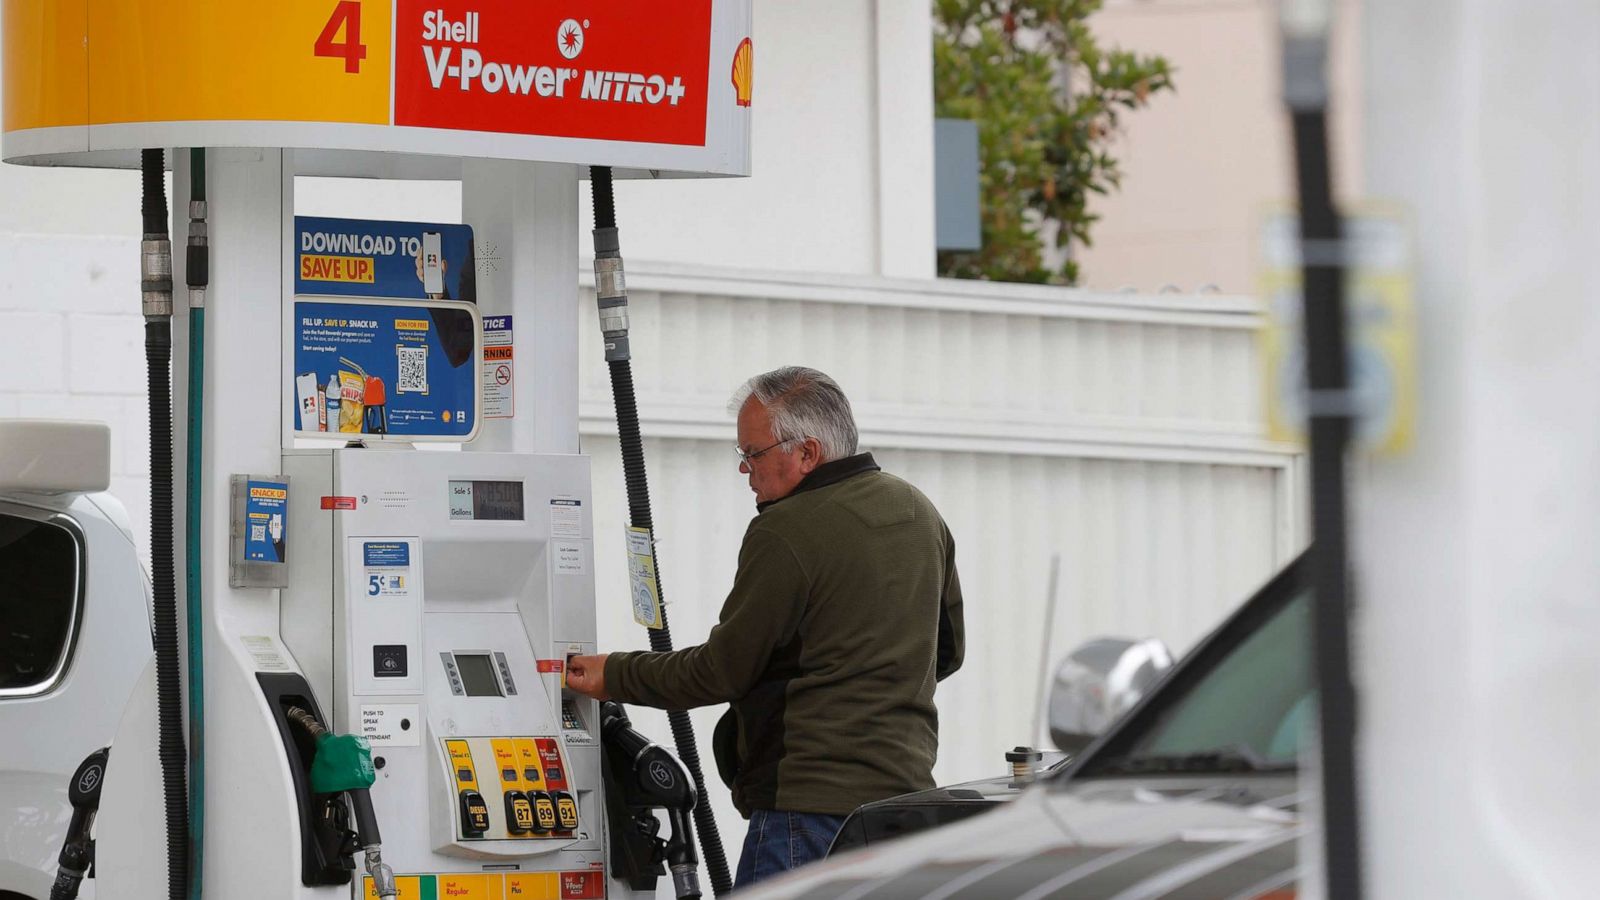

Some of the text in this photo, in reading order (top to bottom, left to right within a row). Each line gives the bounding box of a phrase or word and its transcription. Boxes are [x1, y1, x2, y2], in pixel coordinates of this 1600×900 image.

[422, 10, 479, 44] Shell
[314, 1, 367, 74] 4
[301, 231, 421, 257] DOWNLOAD TO
[302, 256, 373, 281] SAVE UP.
[302, 317, 379, 329] FILL UP. SAVE UP. SNACK UP.
[483, 318, 506, 329] TICE
[484, 348, 512, 359] RNING
[251, 488, 275, 497] SNACK
[454, 487, 466, 495] Sale
[451, 508, 472, 516] Gallons
[469, 806, 488, 815] DIESEL
[516, 808, 530, 821] 87
[539, 808, 553, 820] 89
[561, 807, 575, 820] 91
[446, 888, 469, 897] Regular
[511, 886, 522, 894] Plus
